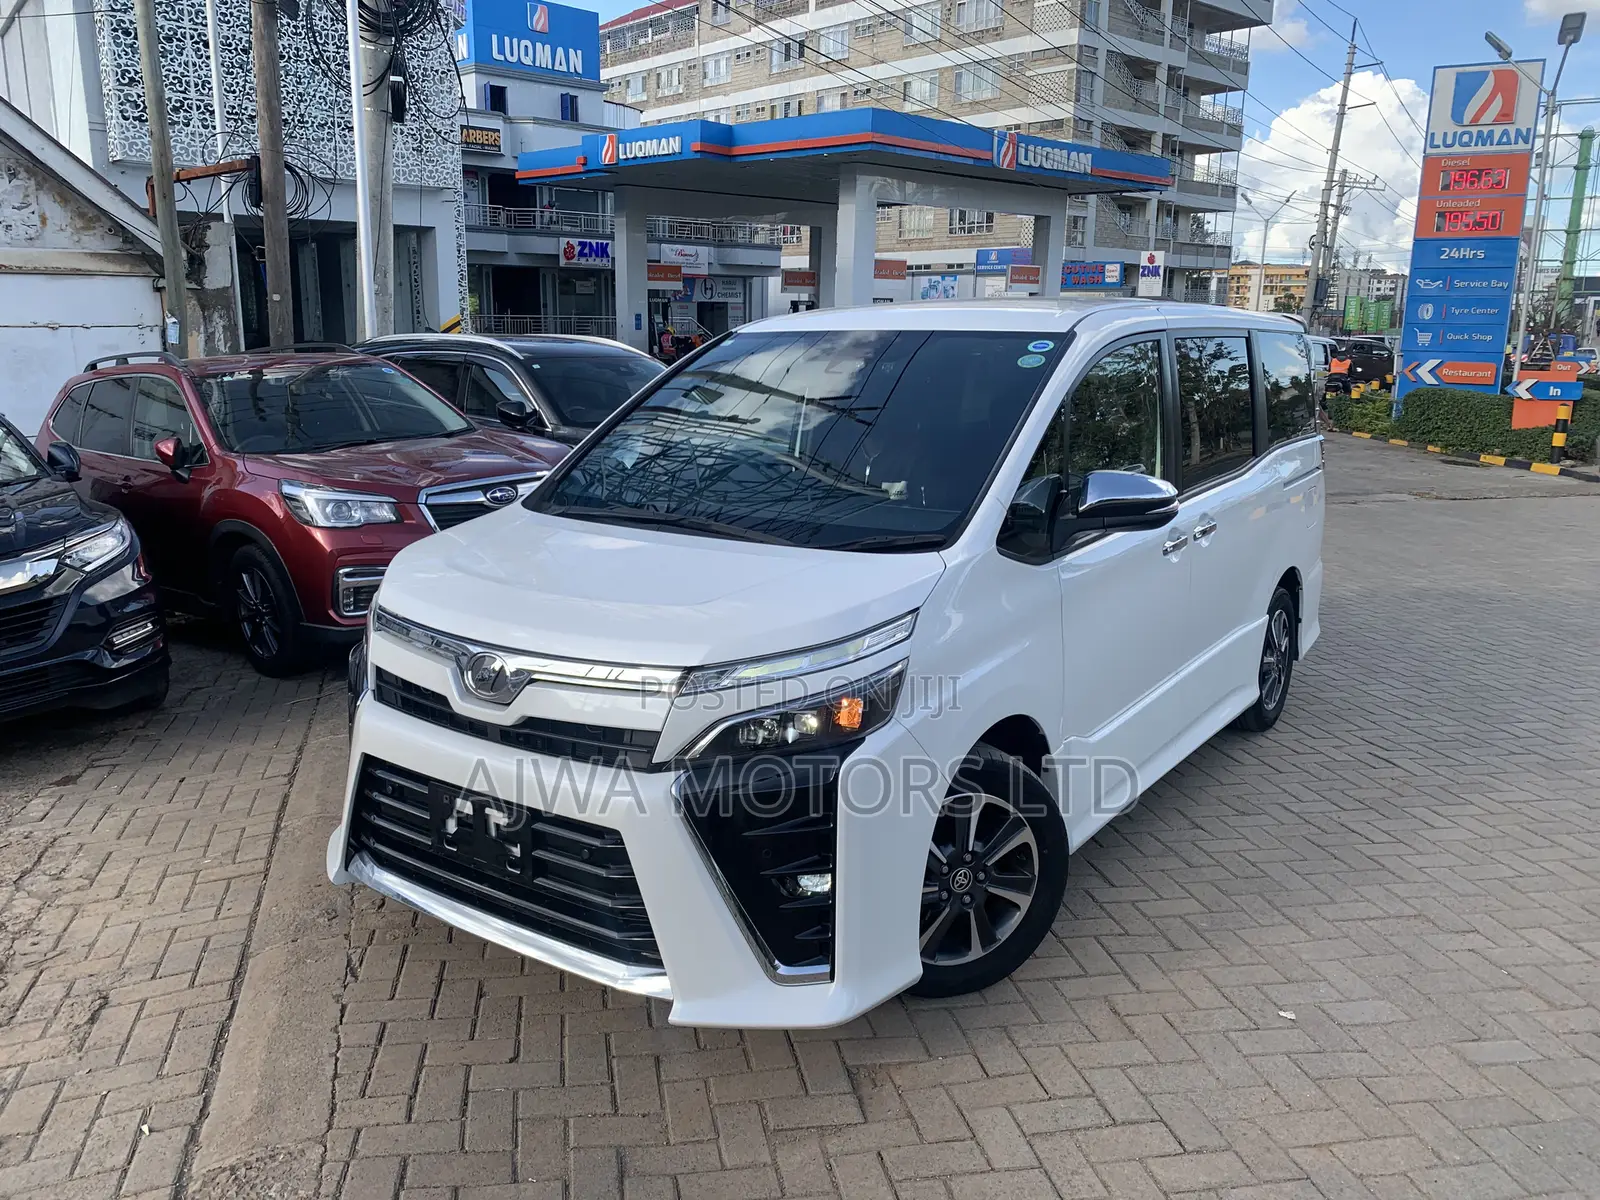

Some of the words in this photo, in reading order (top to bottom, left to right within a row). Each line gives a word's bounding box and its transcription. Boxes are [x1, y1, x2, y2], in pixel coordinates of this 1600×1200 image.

[491, 34, 584, 75] LUQMAN
[461, 128, 501, 146] ARBERS
[1428, 127, 1532, 149] LUQMAN
[618, 136, 682, 160] LUQMAN
[1017, 142, 1092, 174] LUQMAN
[1441, 157, 1471, 167] Diesel
[1449, 168, 1506, 191] 196.63
[1436, 199, 1481, 209] Unleaded
[1444, 211, 1501, 232] 195.50
[577, 240, 611, 258] ZNK
[1439, 247, 1485, 260] 24Hrs
[1062, 263, 1105, 275] CUTIVE
[1140, 265, 1161, 278] ZNK
[1071, 275, 1103, 285] WASH
[1453, 279, 1489, 288] Service
[1490, 279, 1509, 291] Bay
[717, 291, 742, 299] CHEMIST
[1450, 307, 1470, 316] Tyre
[1471, 307, 1500, 315] Center
[1446, 333, 1469, 341] Quick
[1472, 333, 1493, 342] Shop
[1441, 368, 1492, 378] Restaurant
[1556, 363, 1572, 371] Out
[1549, 385, 1561, 397] In
